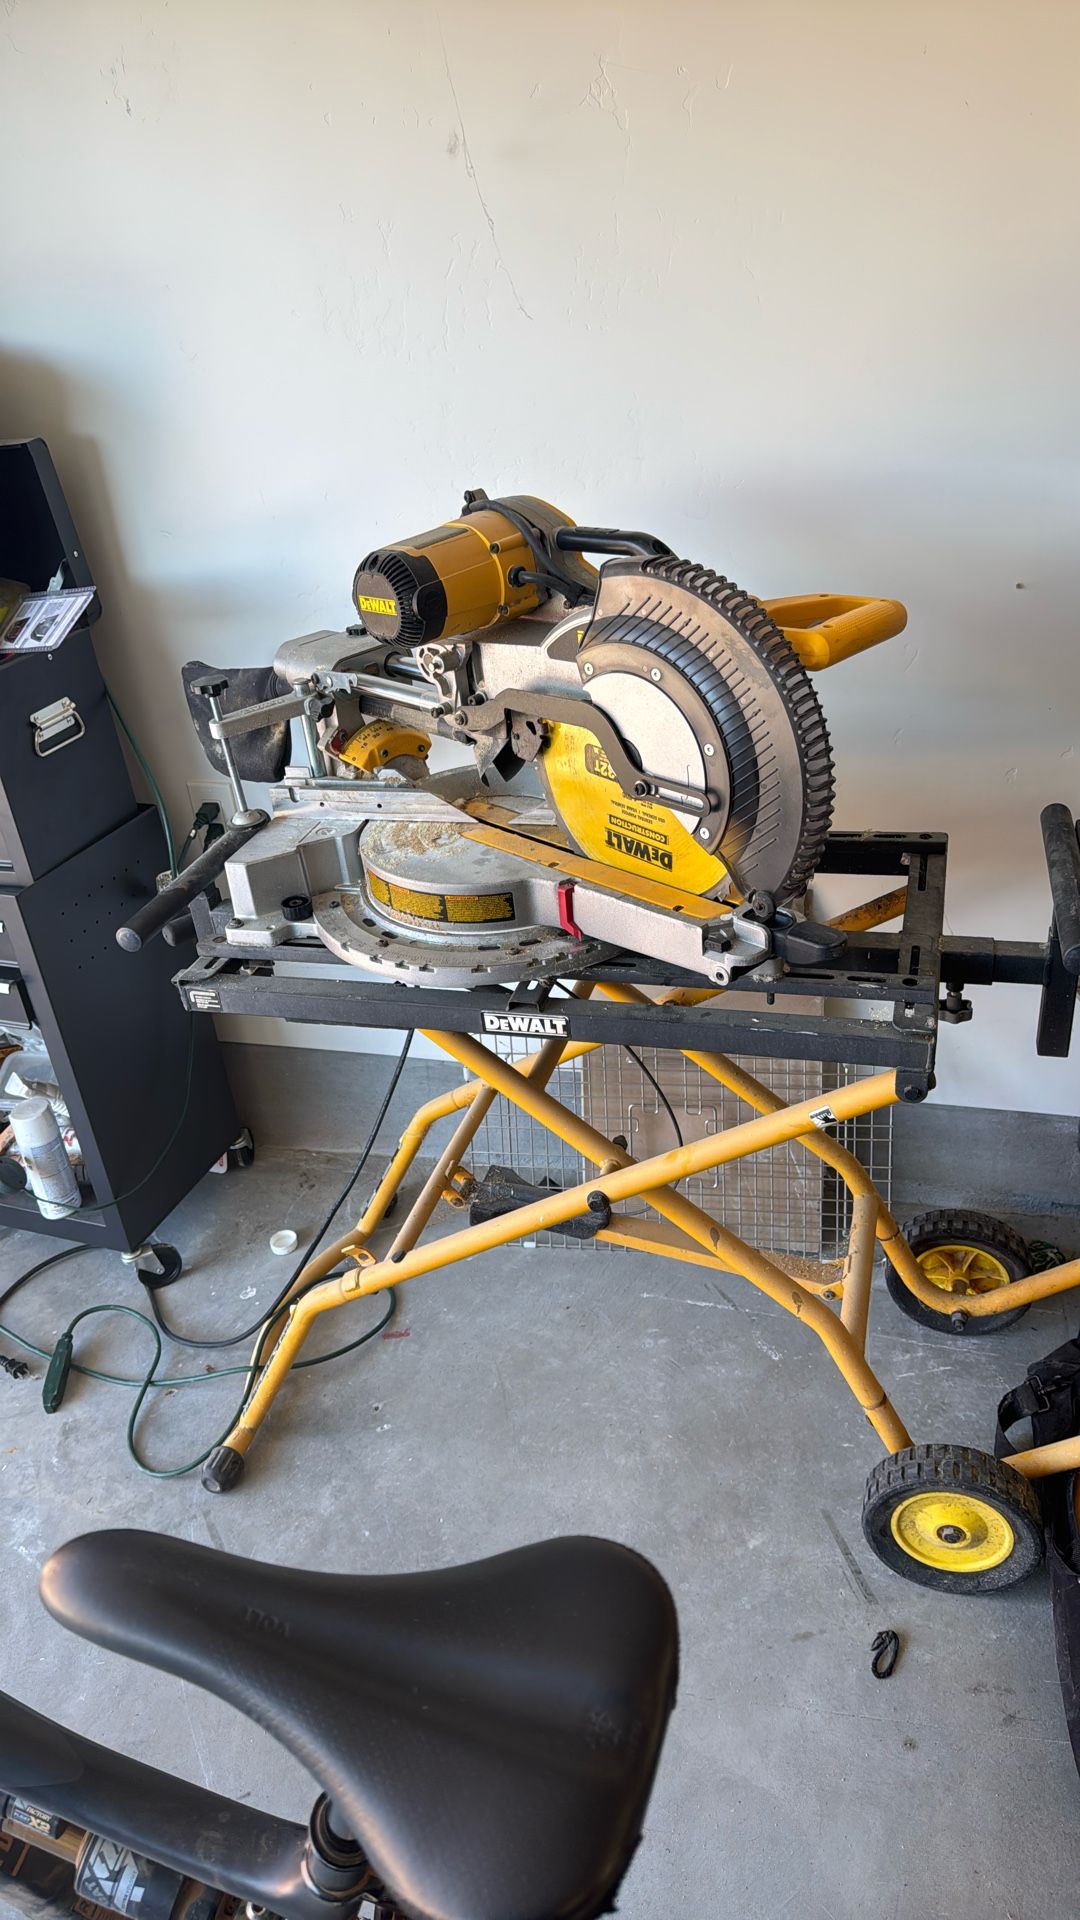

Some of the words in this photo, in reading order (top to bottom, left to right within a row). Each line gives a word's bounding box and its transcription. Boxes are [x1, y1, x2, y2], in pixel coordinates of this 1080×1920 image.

[359, 597, 396, 614] DEWALT
[610, 817, 666, 843] CONSTRUCTION
[605, 831, 673, 870] DEWALT
[484, 1015, 566, 1034] DEWALT
[29, 1817, 51, 1832] X2
